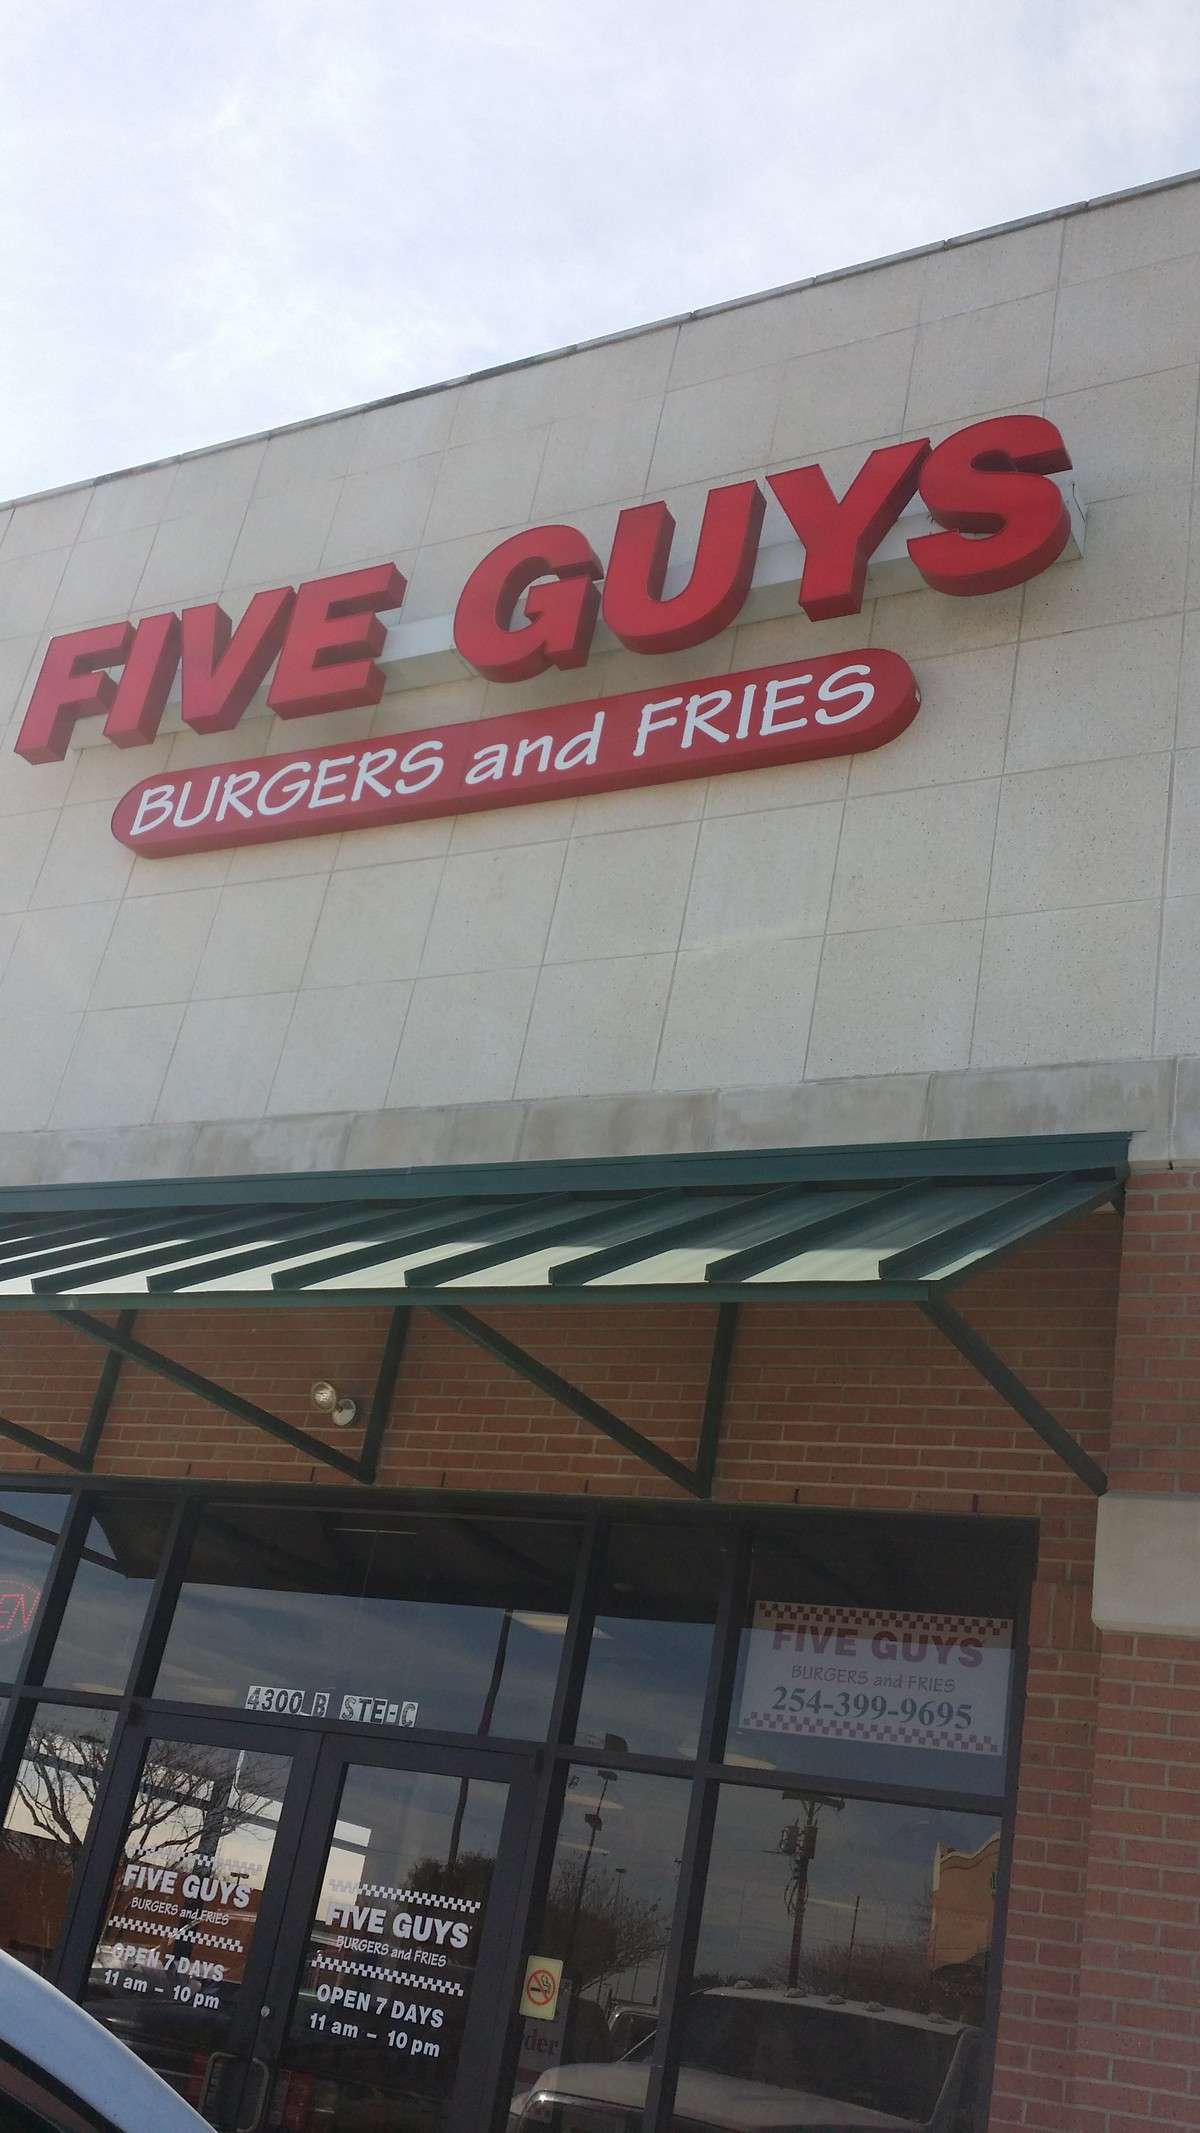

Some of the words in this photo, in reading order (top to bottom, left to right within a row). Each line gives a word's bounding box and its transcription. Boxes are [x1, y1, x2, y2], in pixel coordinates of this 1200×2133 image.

[14, 561, 408, 766] FIVE
[453, 414, 1073, 682] GUYS
[129, 741, 444, 836] BURGERS
[465, 711, 603, 785] and
[631, 664, 875, 757] FRIES
[772, 1622, 859, 1657] FIVE
[871, 1629, 986, 1668] GUYS
[791, 1664, 869, 1686] BURGERS
[873, 1674, 903, 1689] and
[908, 1675, 956, 1693] FRIES
[246, 1687, 303, 1714] 4300
[314, 1694, 328, 1717] B
[770, 1685, 973, 1730] 254-399-9695
[122, 1863, 179, 1894] FIVE
[181, 1874, 251, 1909] GUYS
[131, 1896, 178, 1916] BURGERS
[179, 1906, 201, 1921] and
[200, 1911, 230, 1926] FRIES
[325, 1901, 387, 1934] FIVE
[392, 1911, 470, 1949] GUYS
[112, 1942, 160, 1970] OPEN
[164, 1954, 175, 1970] 7
[177, 1957, 225, 1982] DAYS
[337, 1935, 389, 1956] BURGERS
[390, 1948, 412, 1961] and
[413, 1949, 447, 1968] FRIES
[104, 1969, 119, 1986] 11
[122, 1977, 147, 1993] am
[173, 1985, 191, 2002] 10
[192, 1992, 220, 2009] pm
[316, 1983, 371, 2012] OPEN
[375, 1997, 388, 2015] 7
[390, 2000, 444, 2029] DAYS
[310, 2012, 326, 2030] 11
[331, 2021, 359, 2039] am
[387, 2030, 408, 2049] 10
[410, 2039, 440, 2057] pm
